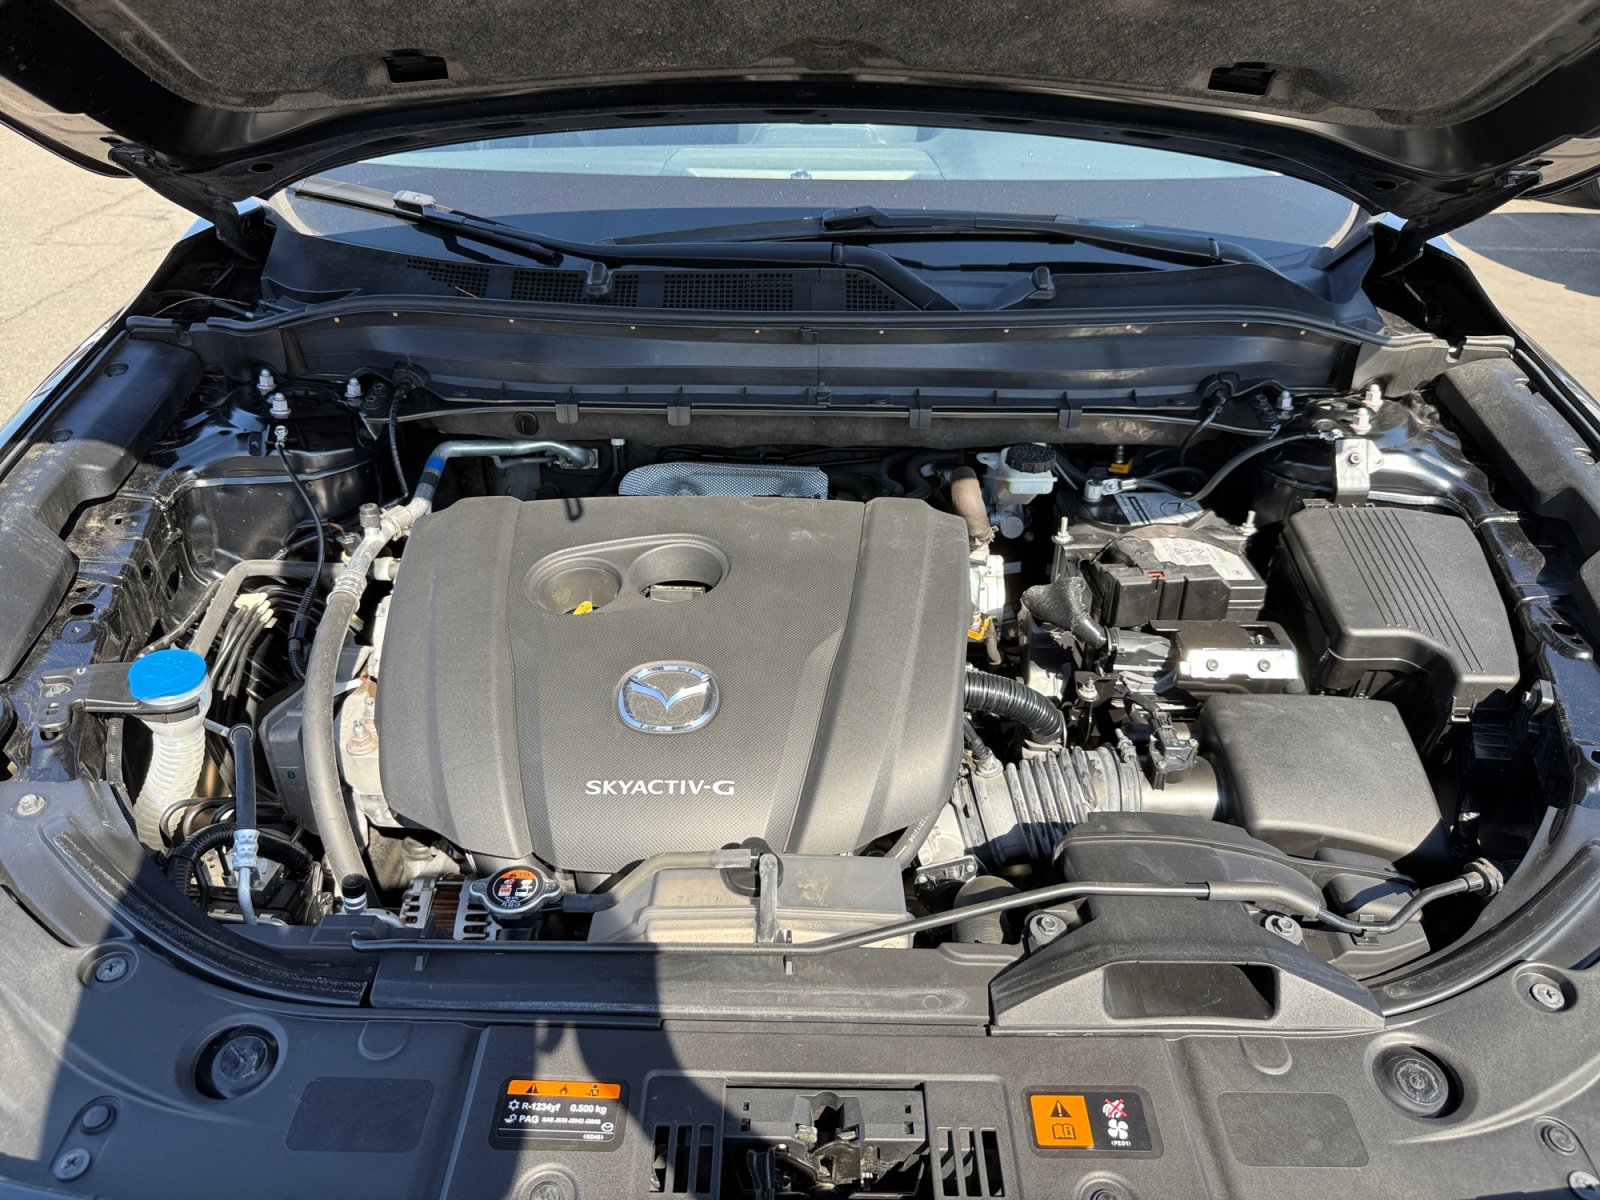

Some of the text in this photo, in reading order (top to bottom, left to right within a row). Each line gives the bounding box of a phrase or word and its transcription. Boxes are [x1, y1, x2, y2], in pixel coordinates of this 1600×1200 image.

[585, 779, 736, 796] SKYACTIV-G
[521, 1102, 607, 1115] R-1234yf 0.500 kg
[518, 1114, 540, 1124] PAG
